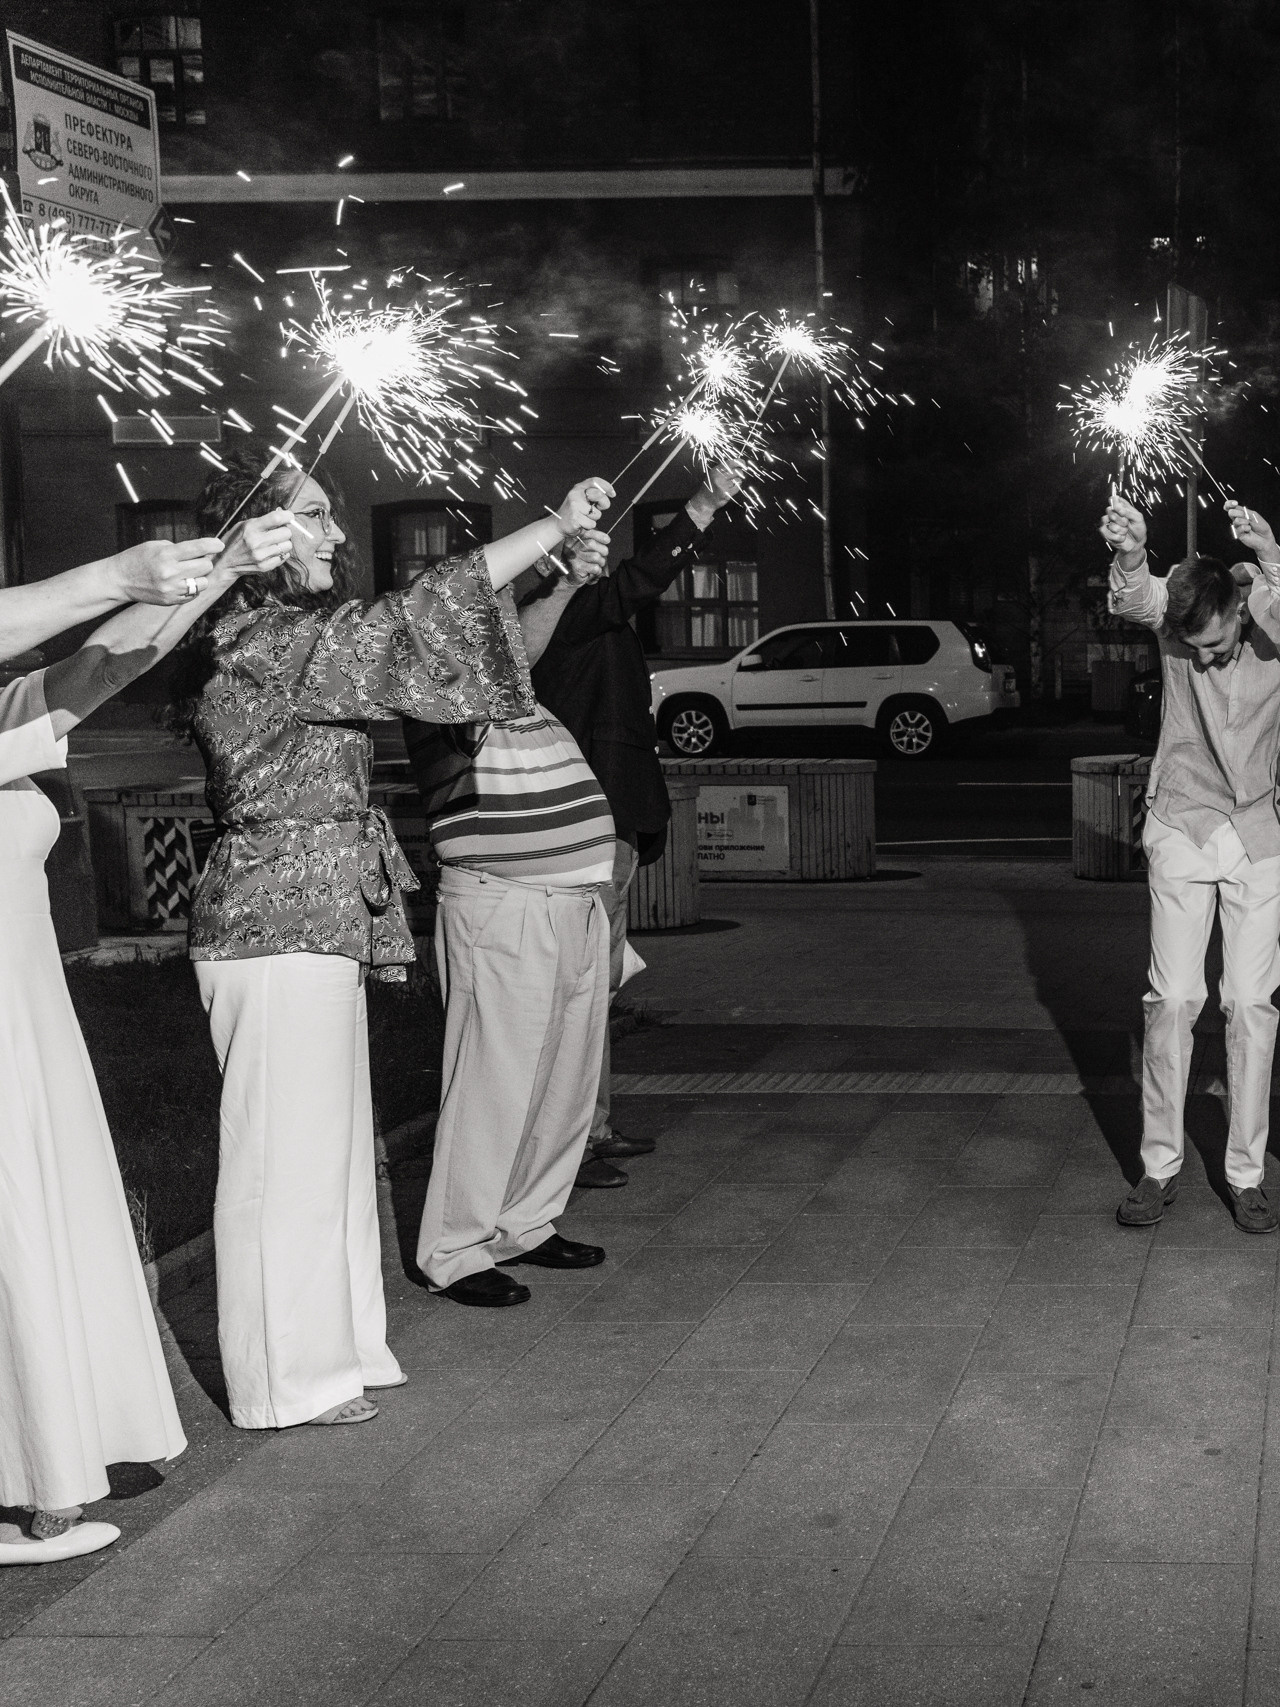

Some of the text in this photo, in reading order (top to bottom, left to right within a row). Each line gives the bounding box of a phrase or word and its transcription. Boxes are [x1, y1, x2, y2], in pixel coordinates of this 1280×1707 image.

[21, 53, 63, 79] ДЕПАРТАМЕНТ
[64, 70, 118, 100] ТЕРРИТОРИАЛЬНЫХ
[30, 71, 85, 101] ИСПОЛНИТЕЛЬНОЙ
[85, 91, 108, 110] ВЛАСТИ
[65, 113, 133, 151] ПРЕФЕКТУРА
[66, 138, 153, 181] СЕВЕРО-ВОСТОЧНОГО
[68, 163, 154, 203] АДМИНИСТРАТИВНОГО
[69, 183, 99, 205] ОКРУГА
[39, 203, 46, 217] 8
[78, 214, 124, 236] 777-77-
